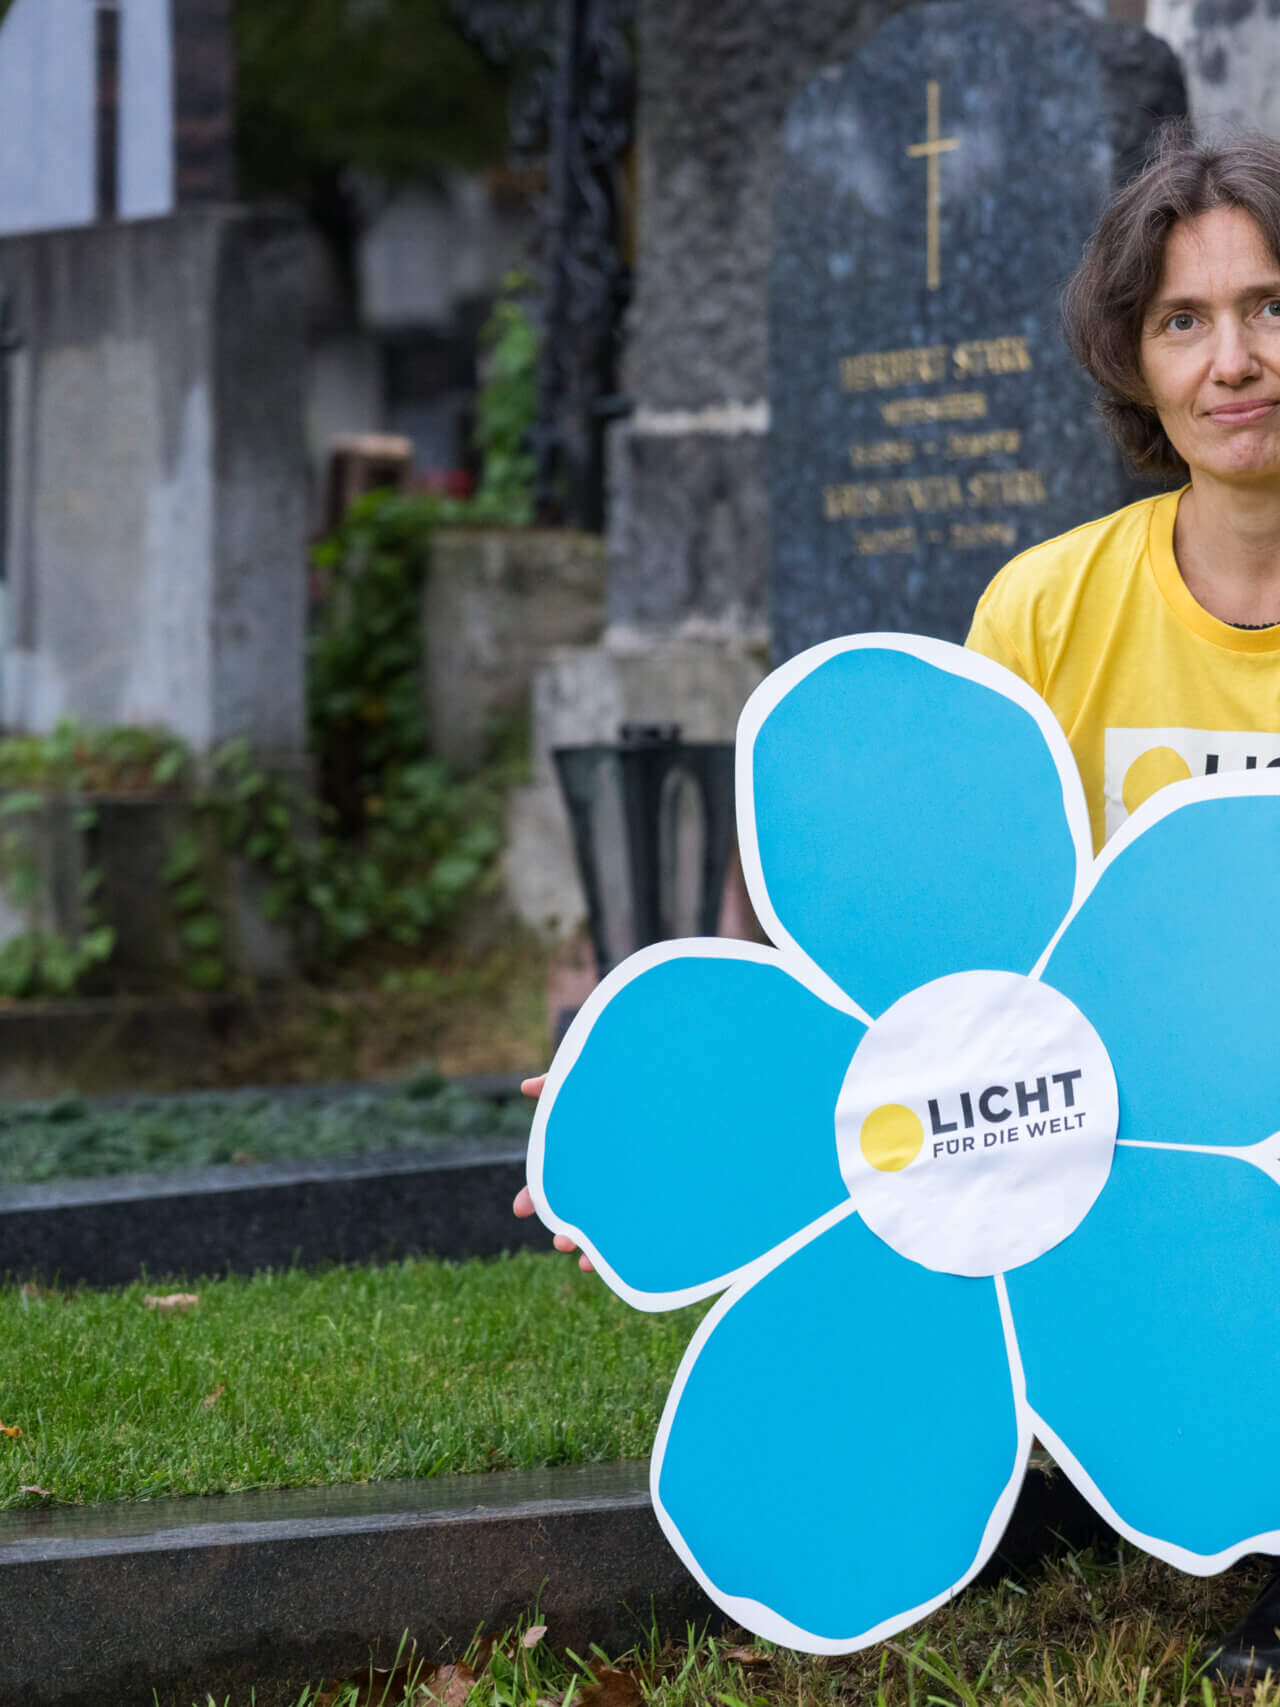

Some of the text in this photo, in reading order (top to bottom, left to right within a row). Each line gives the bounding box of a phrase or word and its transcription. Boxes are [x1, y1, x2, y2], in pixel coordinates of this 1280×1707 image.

[928, 1070, 1082, 1135] LICHT
[933, 1113, 1086, 1158] FÜR DIE WELT
